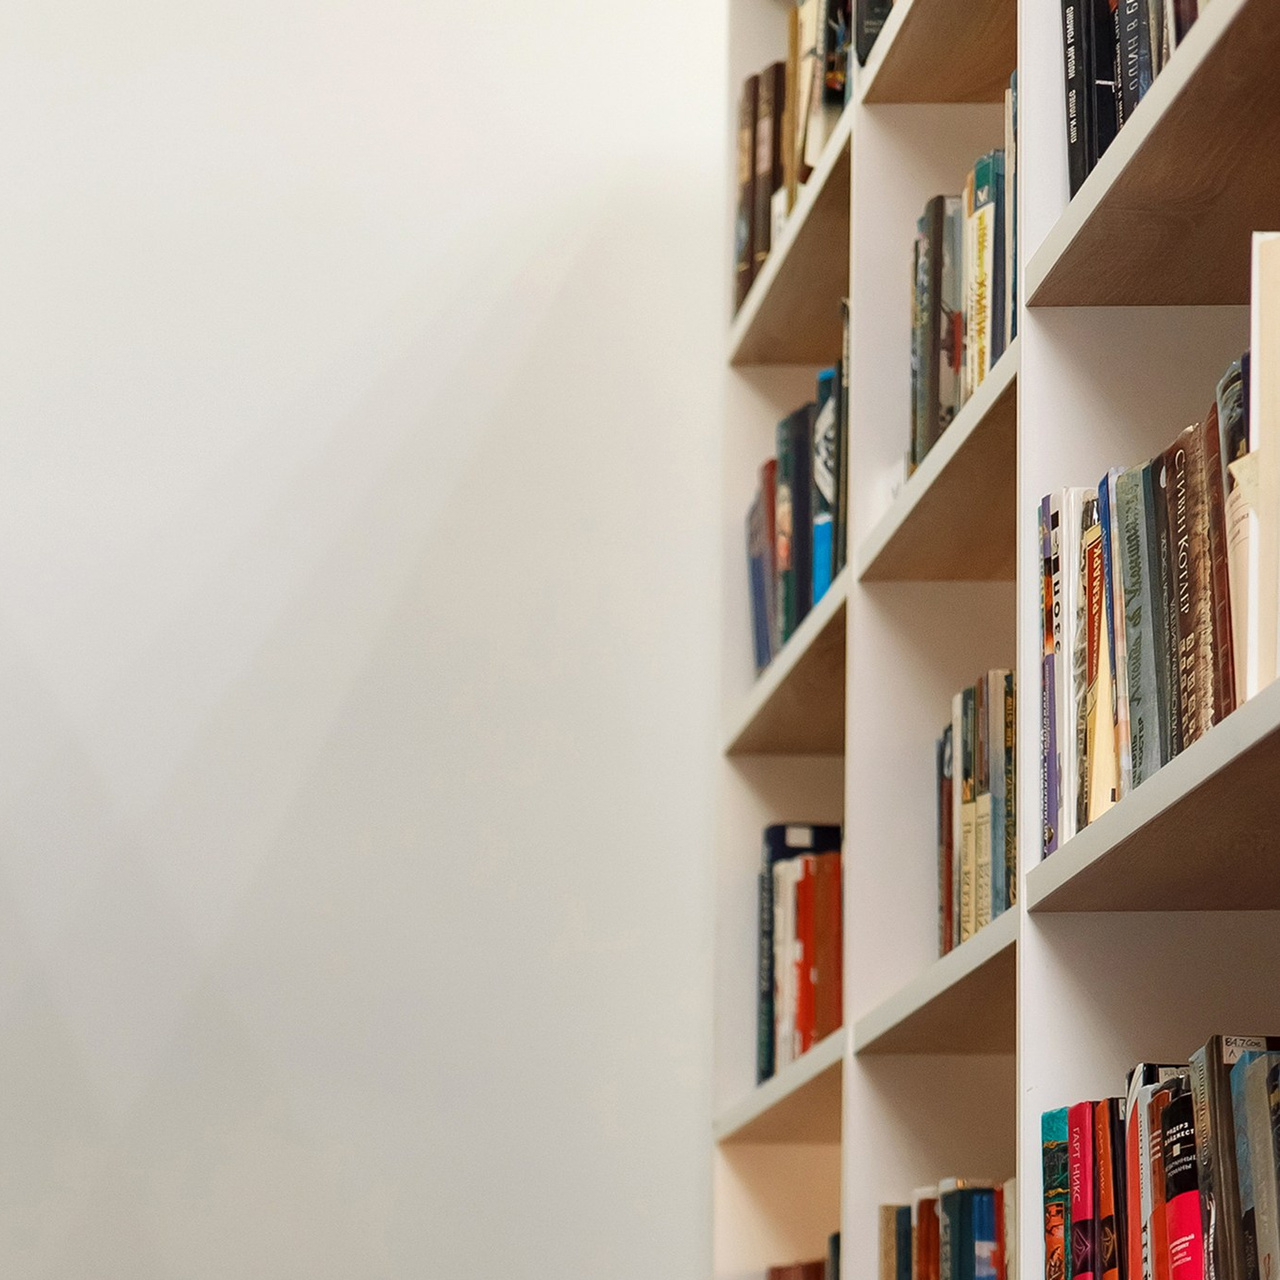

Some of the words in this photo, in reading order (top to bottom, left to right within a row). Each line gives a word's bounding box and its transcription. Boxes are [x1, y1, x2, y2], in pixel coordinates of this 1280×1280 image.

[1091, 542, 1102, 615] РЕМАРК
[1177, 533, 1191, 614] КОТЛЕР
[1053, 579, 1062, 655] ЭЗОП
[1072, 1125, 1081, 1158] ГАРТ
[1072, 1162, 1081, 1203] НИКС
